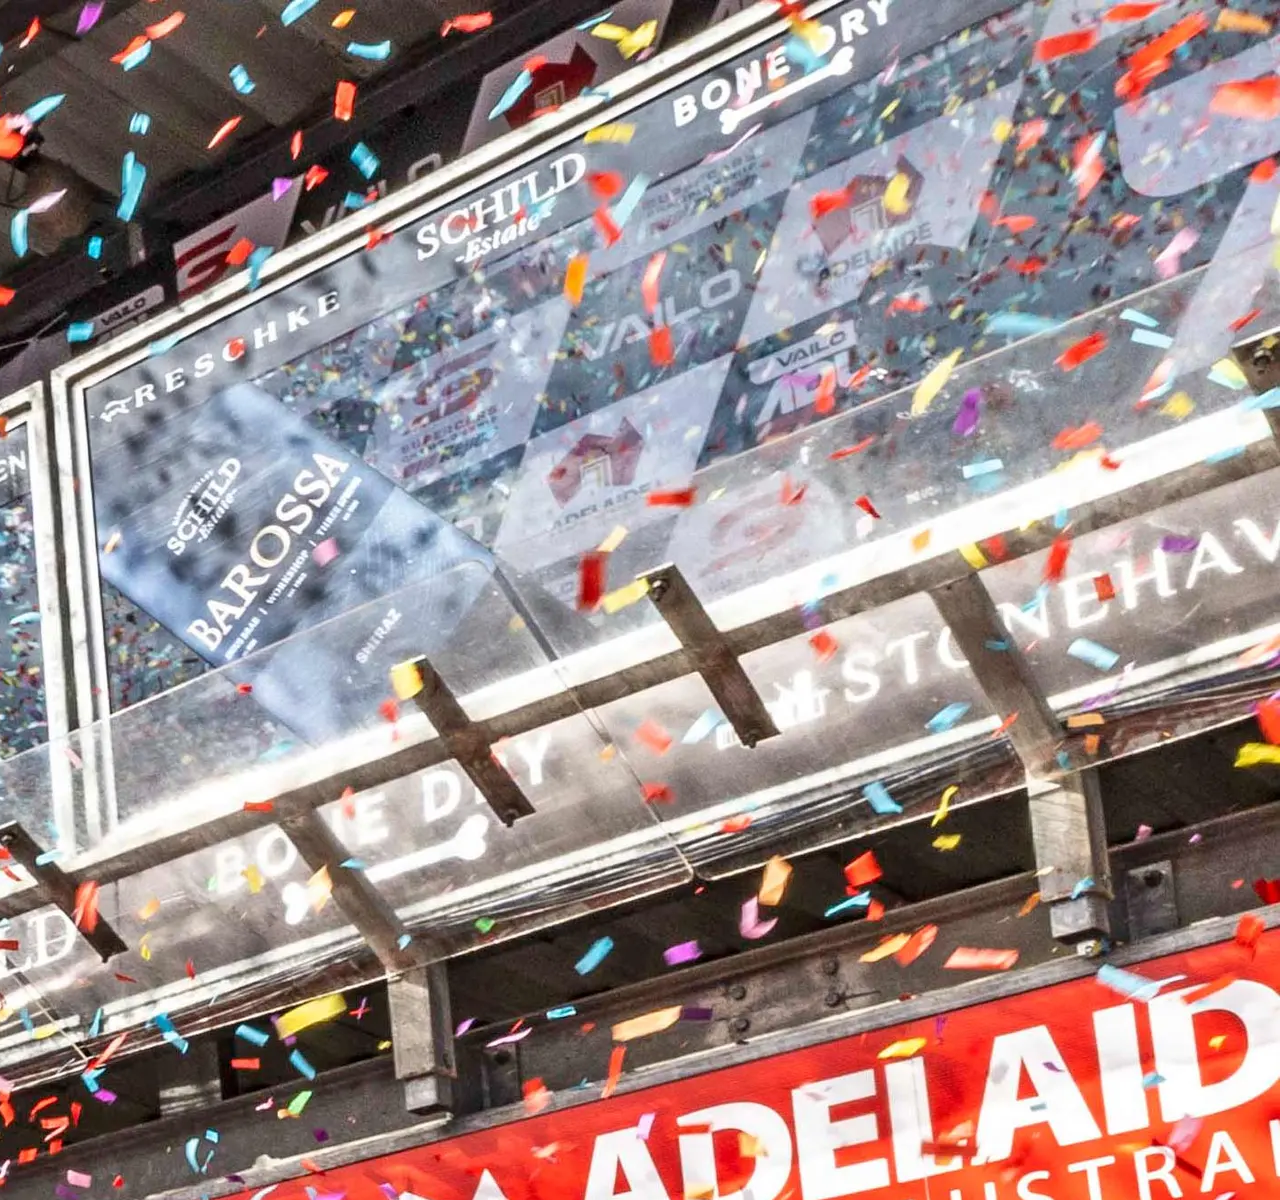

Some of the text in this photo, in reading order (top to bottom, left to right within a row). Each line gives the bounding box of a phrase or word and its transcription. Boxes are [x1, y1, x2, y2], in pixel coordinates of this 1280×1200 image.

[673, 45, 791, 127] BONE
[416, 152, 587, 261] SCHILD
[135, 290, 341, 408] RESCHKE
[776, 330, 848, 368] VAILO
[167, 457, 243, 556] SCHILD
[186, 452, 351, 652] BAROSSA
[355, 607, 402, 665] SHIRAZ
[212, 732, 552, 896] BOE DY
